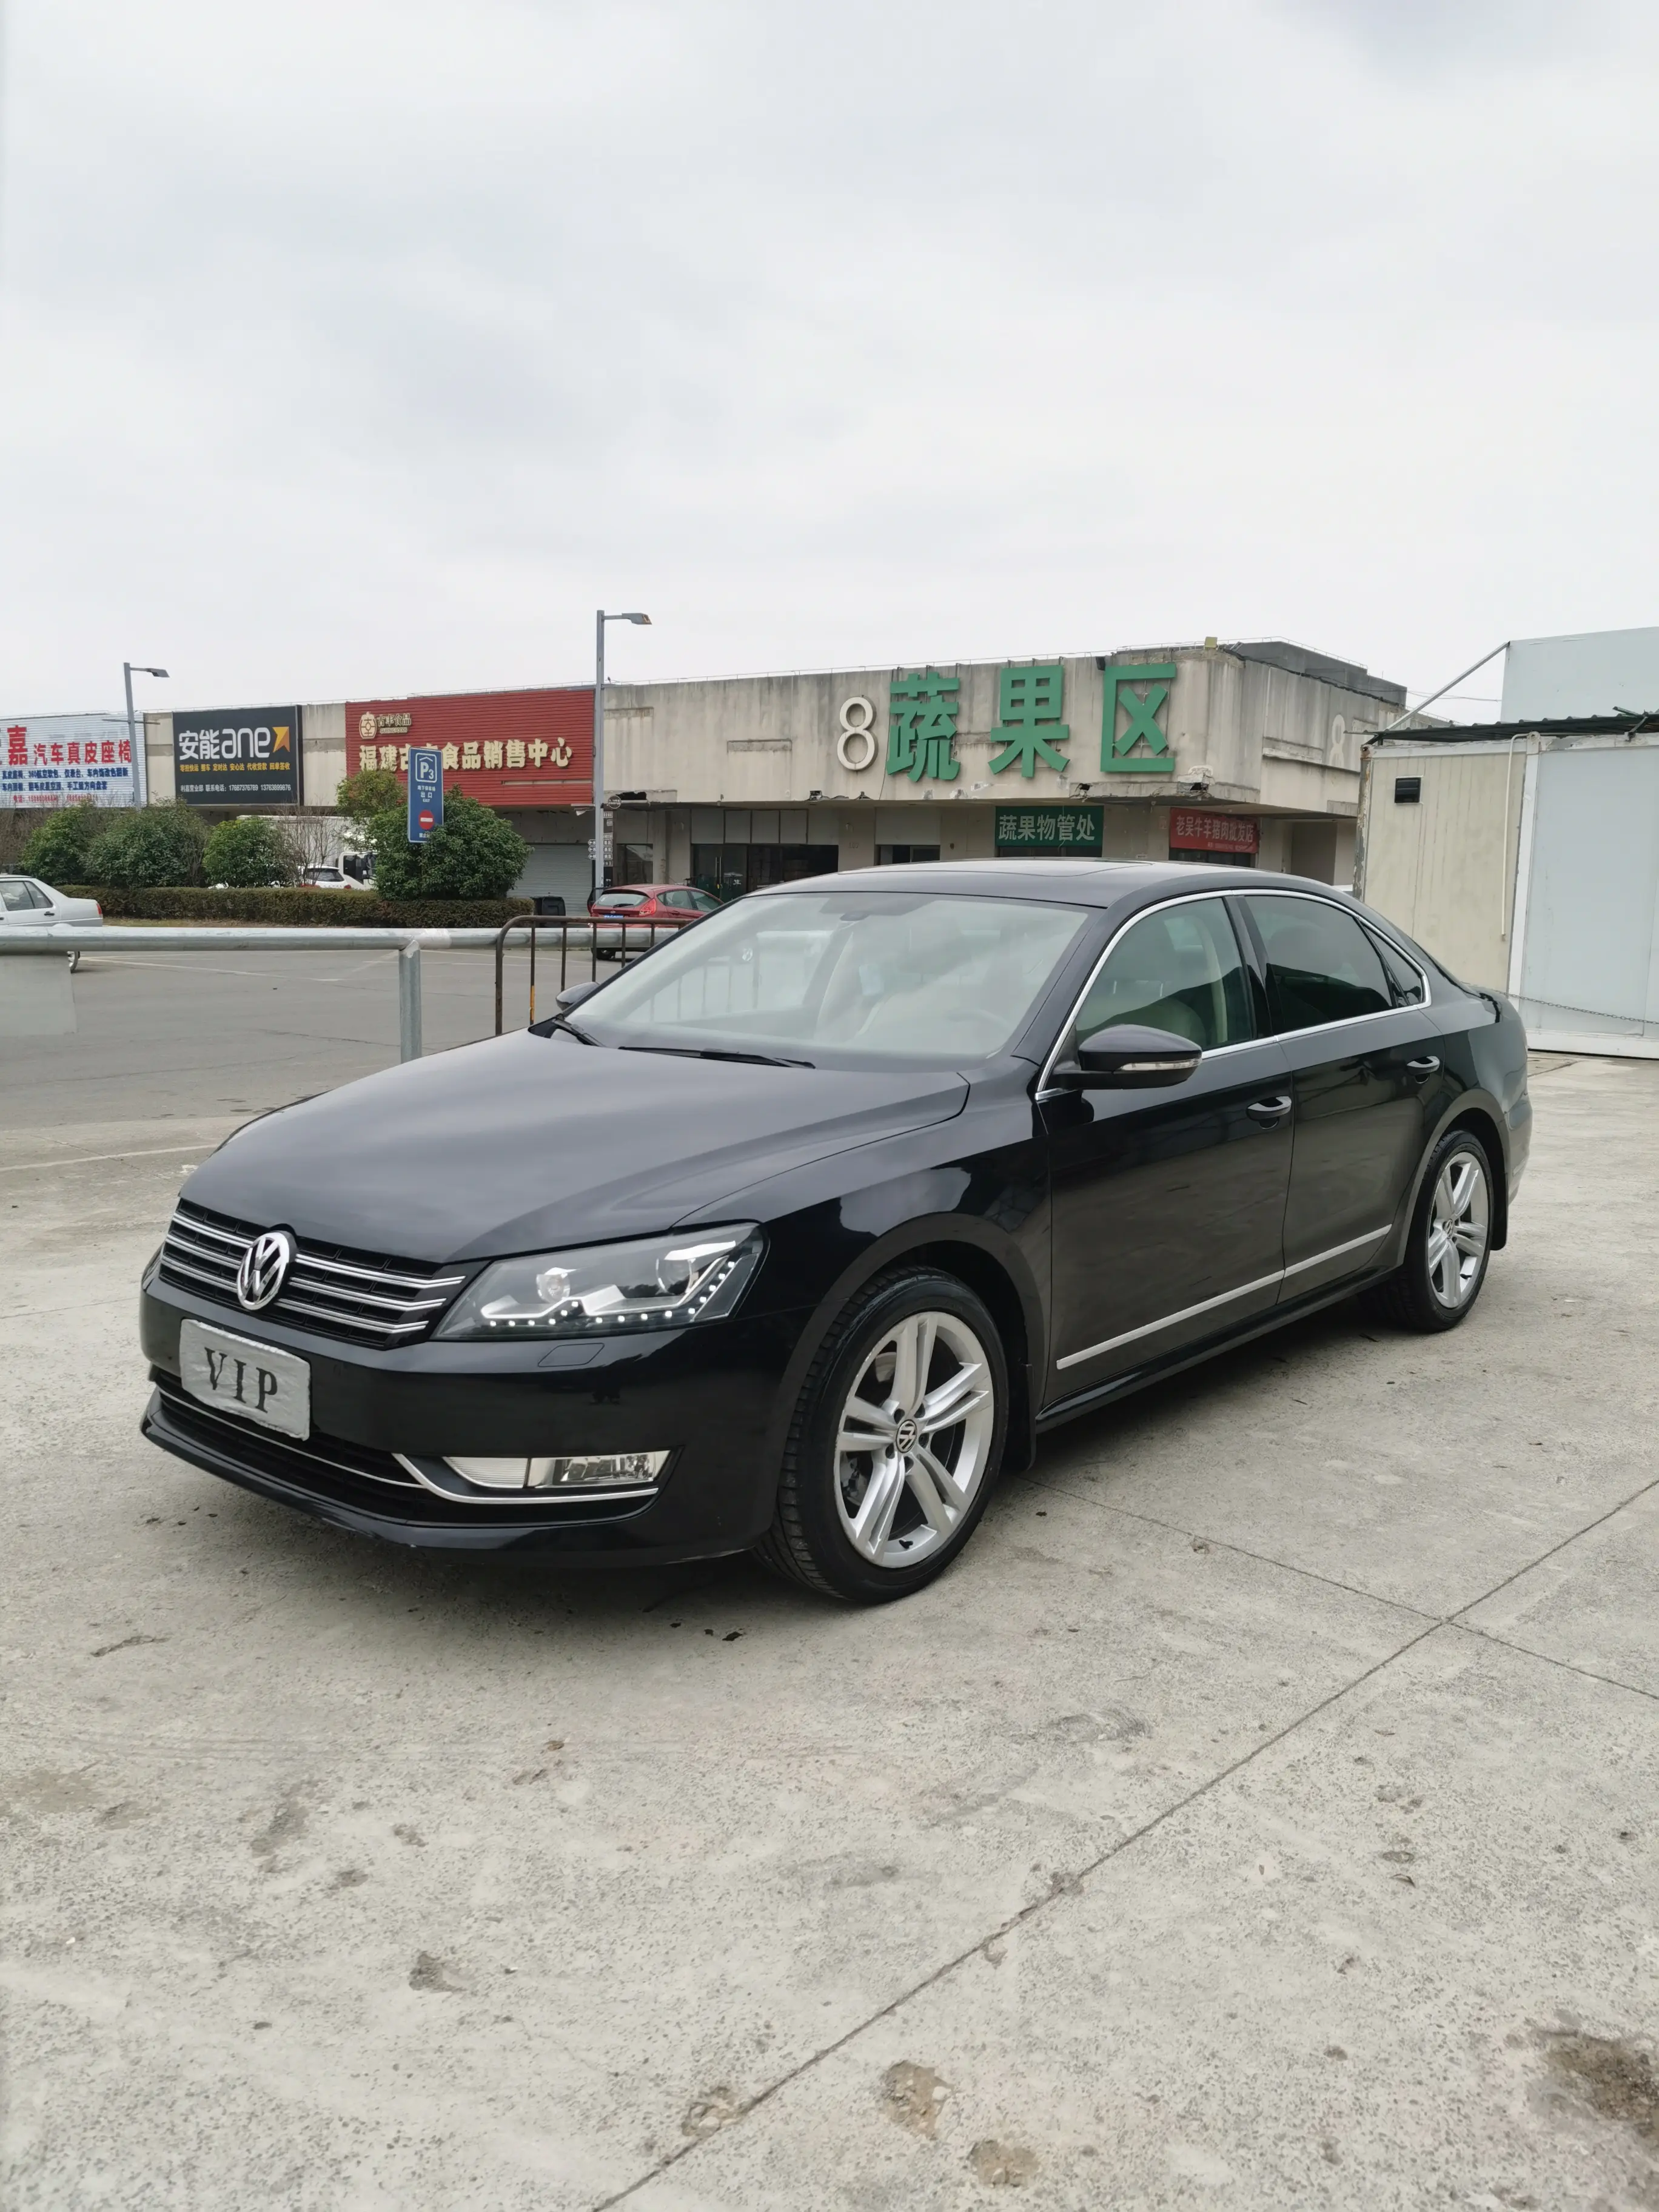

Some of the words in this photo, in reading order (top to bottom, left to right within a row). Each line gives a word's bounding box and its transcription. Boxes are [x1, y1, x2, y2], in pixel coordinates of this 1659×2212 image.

[837, 697, 877, 771] 8
[886, 663, 1176, 782] 蔬果区
[0, 725, 28, 766] 嘉
[34, 739, 132, 766] 汽车真皮座椅
[359, 737, 572, 771] 福建古食品销售中心
[998, 814, 1095, 841] 蔬果物管处
[1176, 815, 1255, 843] 老吴牛羊猪肉批发店
[204, 1347, 278, 1413] VIP
